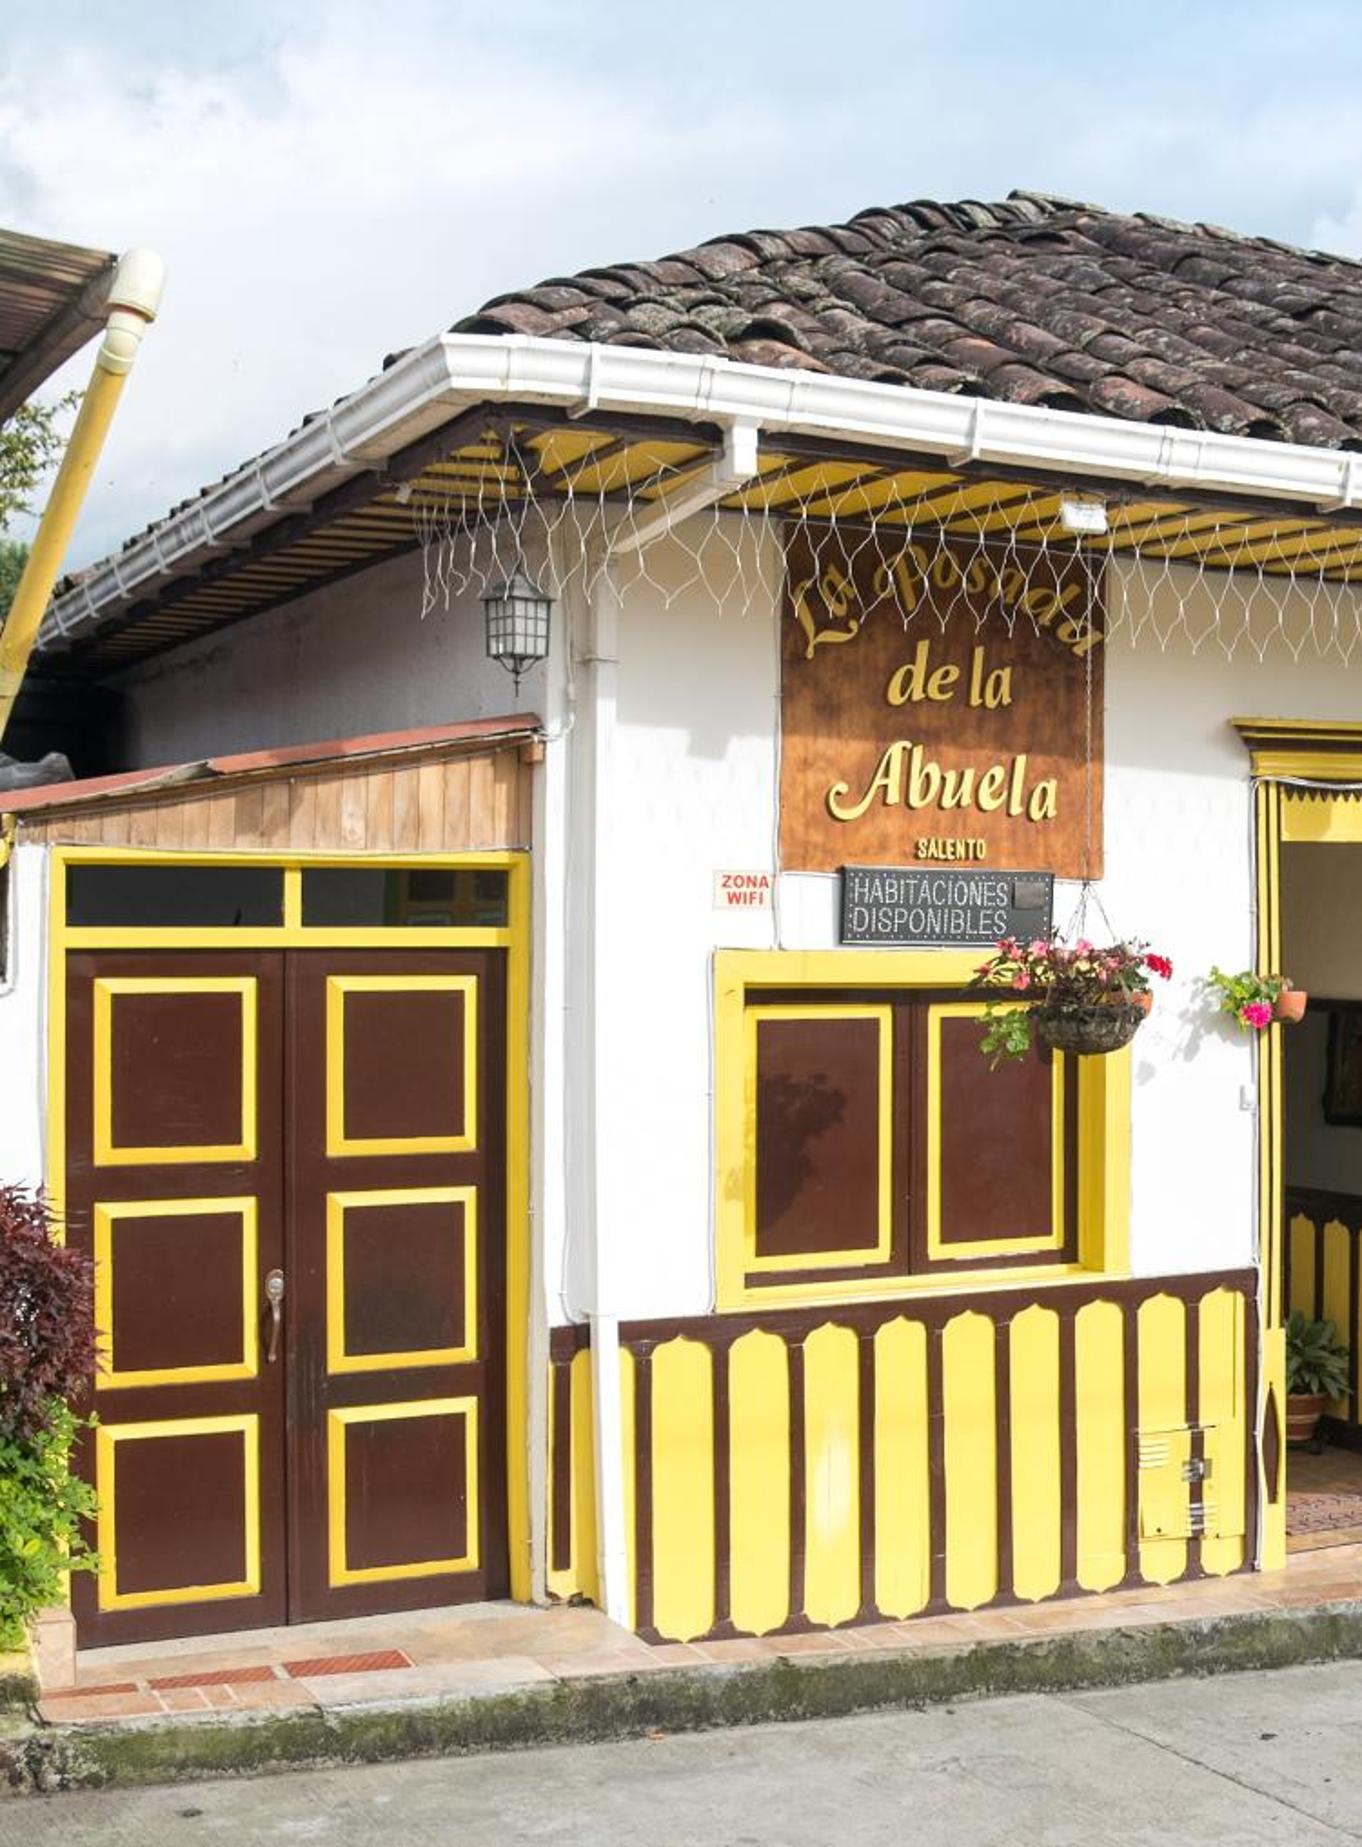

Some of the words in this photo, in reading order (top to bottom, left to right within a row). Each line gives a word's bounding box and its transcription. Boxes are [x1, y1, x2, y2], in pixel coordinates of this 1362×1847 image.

[793, 561, 858, 660] La
[873, 544, 1104, 657] Posada
[887, 639, 960, 706] de
[969, 645, 1013, 710] la
[826, 740, 1058, 822] Abuela
[916, 838, 987, 860] SALENTO
[722, 874, 770, 889] ZONA
[854, 877, 1008, 908] HABITACIONES
[726, 891, 764, 905] WIFI
[852, 908, 1008, 935] DISPONIBLES
